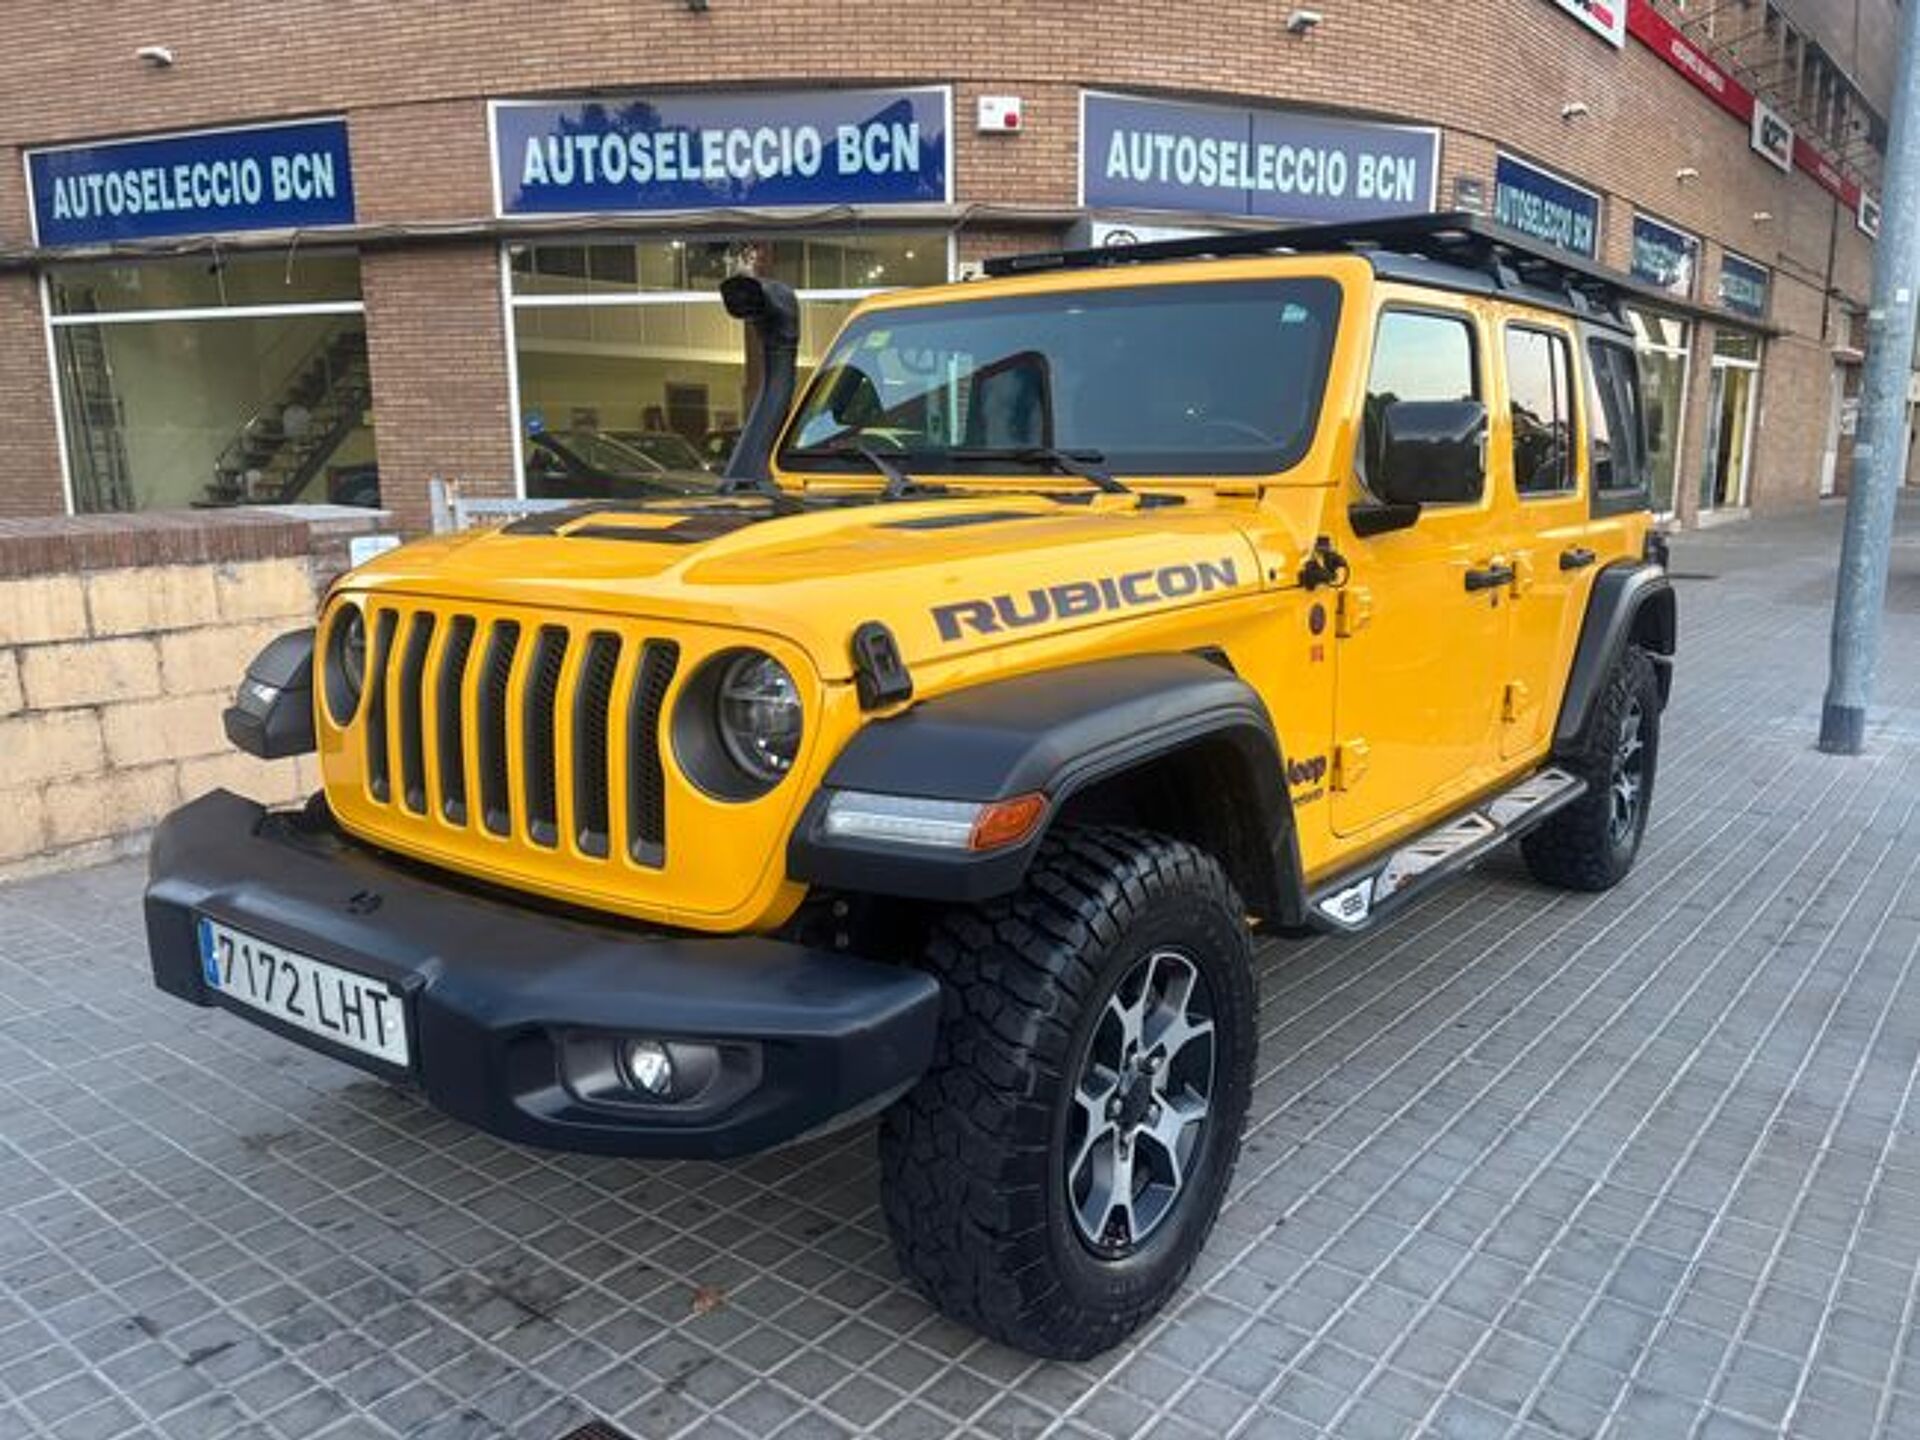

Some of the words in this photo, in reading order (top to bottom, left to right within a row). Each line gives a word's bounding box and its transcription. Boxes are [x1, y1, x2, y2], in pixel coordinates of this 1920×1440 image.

[53, 158, 262, 220] AUTOSELECCIO
[270, 152, 335, 202] BCN
[522, 126, 822, 186] AUTOSELECCIO
[837, 123, 920, 174] BCN
[1106, 129, 1347, 197] AUTOSELECCIO
[1357, 153, 1417, 202] BCN
[930, 557, 1239, 643] RUBICON
[218, 934, 306, 1018] 7172
[312, 970, 389, 1049] LHT
